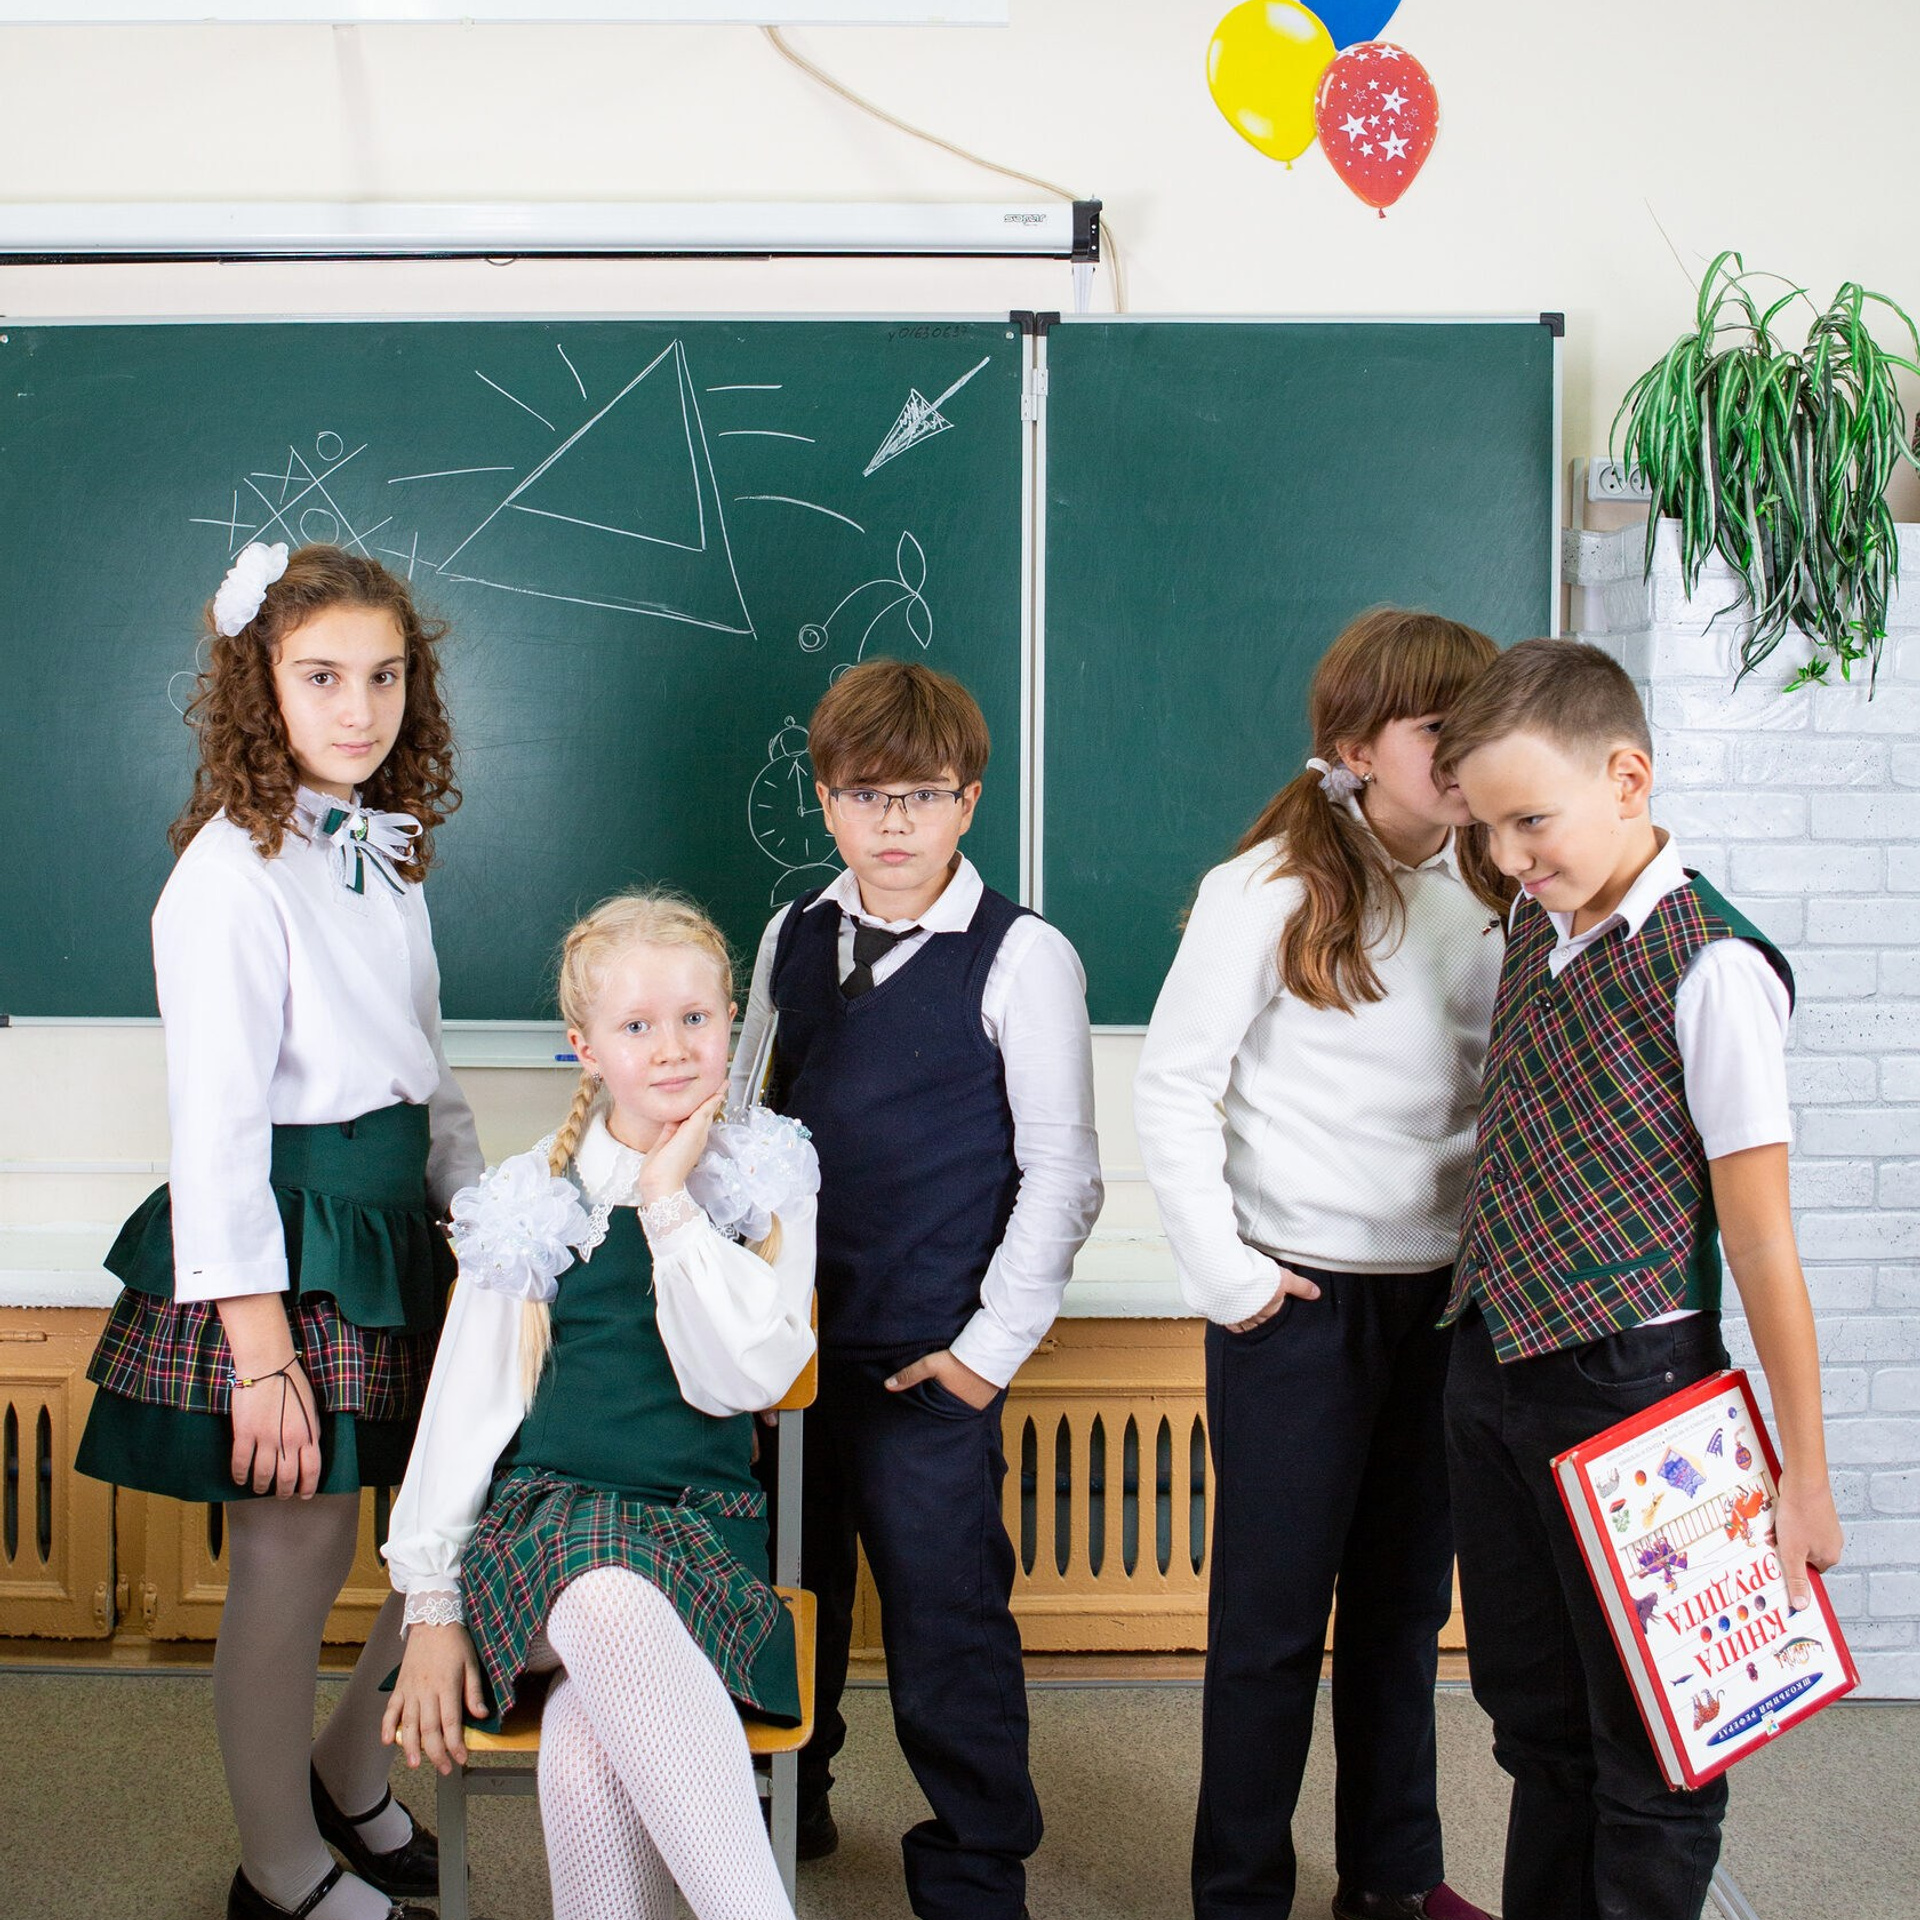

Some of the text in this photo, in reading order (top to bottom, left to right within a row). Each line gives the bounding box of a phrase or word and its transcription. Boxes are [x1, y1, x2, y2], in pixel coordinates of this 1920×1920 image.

[1664, 1551, 1781, 1636] ЭРУДИТА
[1693, 1606, 1787, 1678] КНИГА
[1718, 1677, 1811, 1739] ШКОЛЬНЫЙ РЕФЕРАТ
